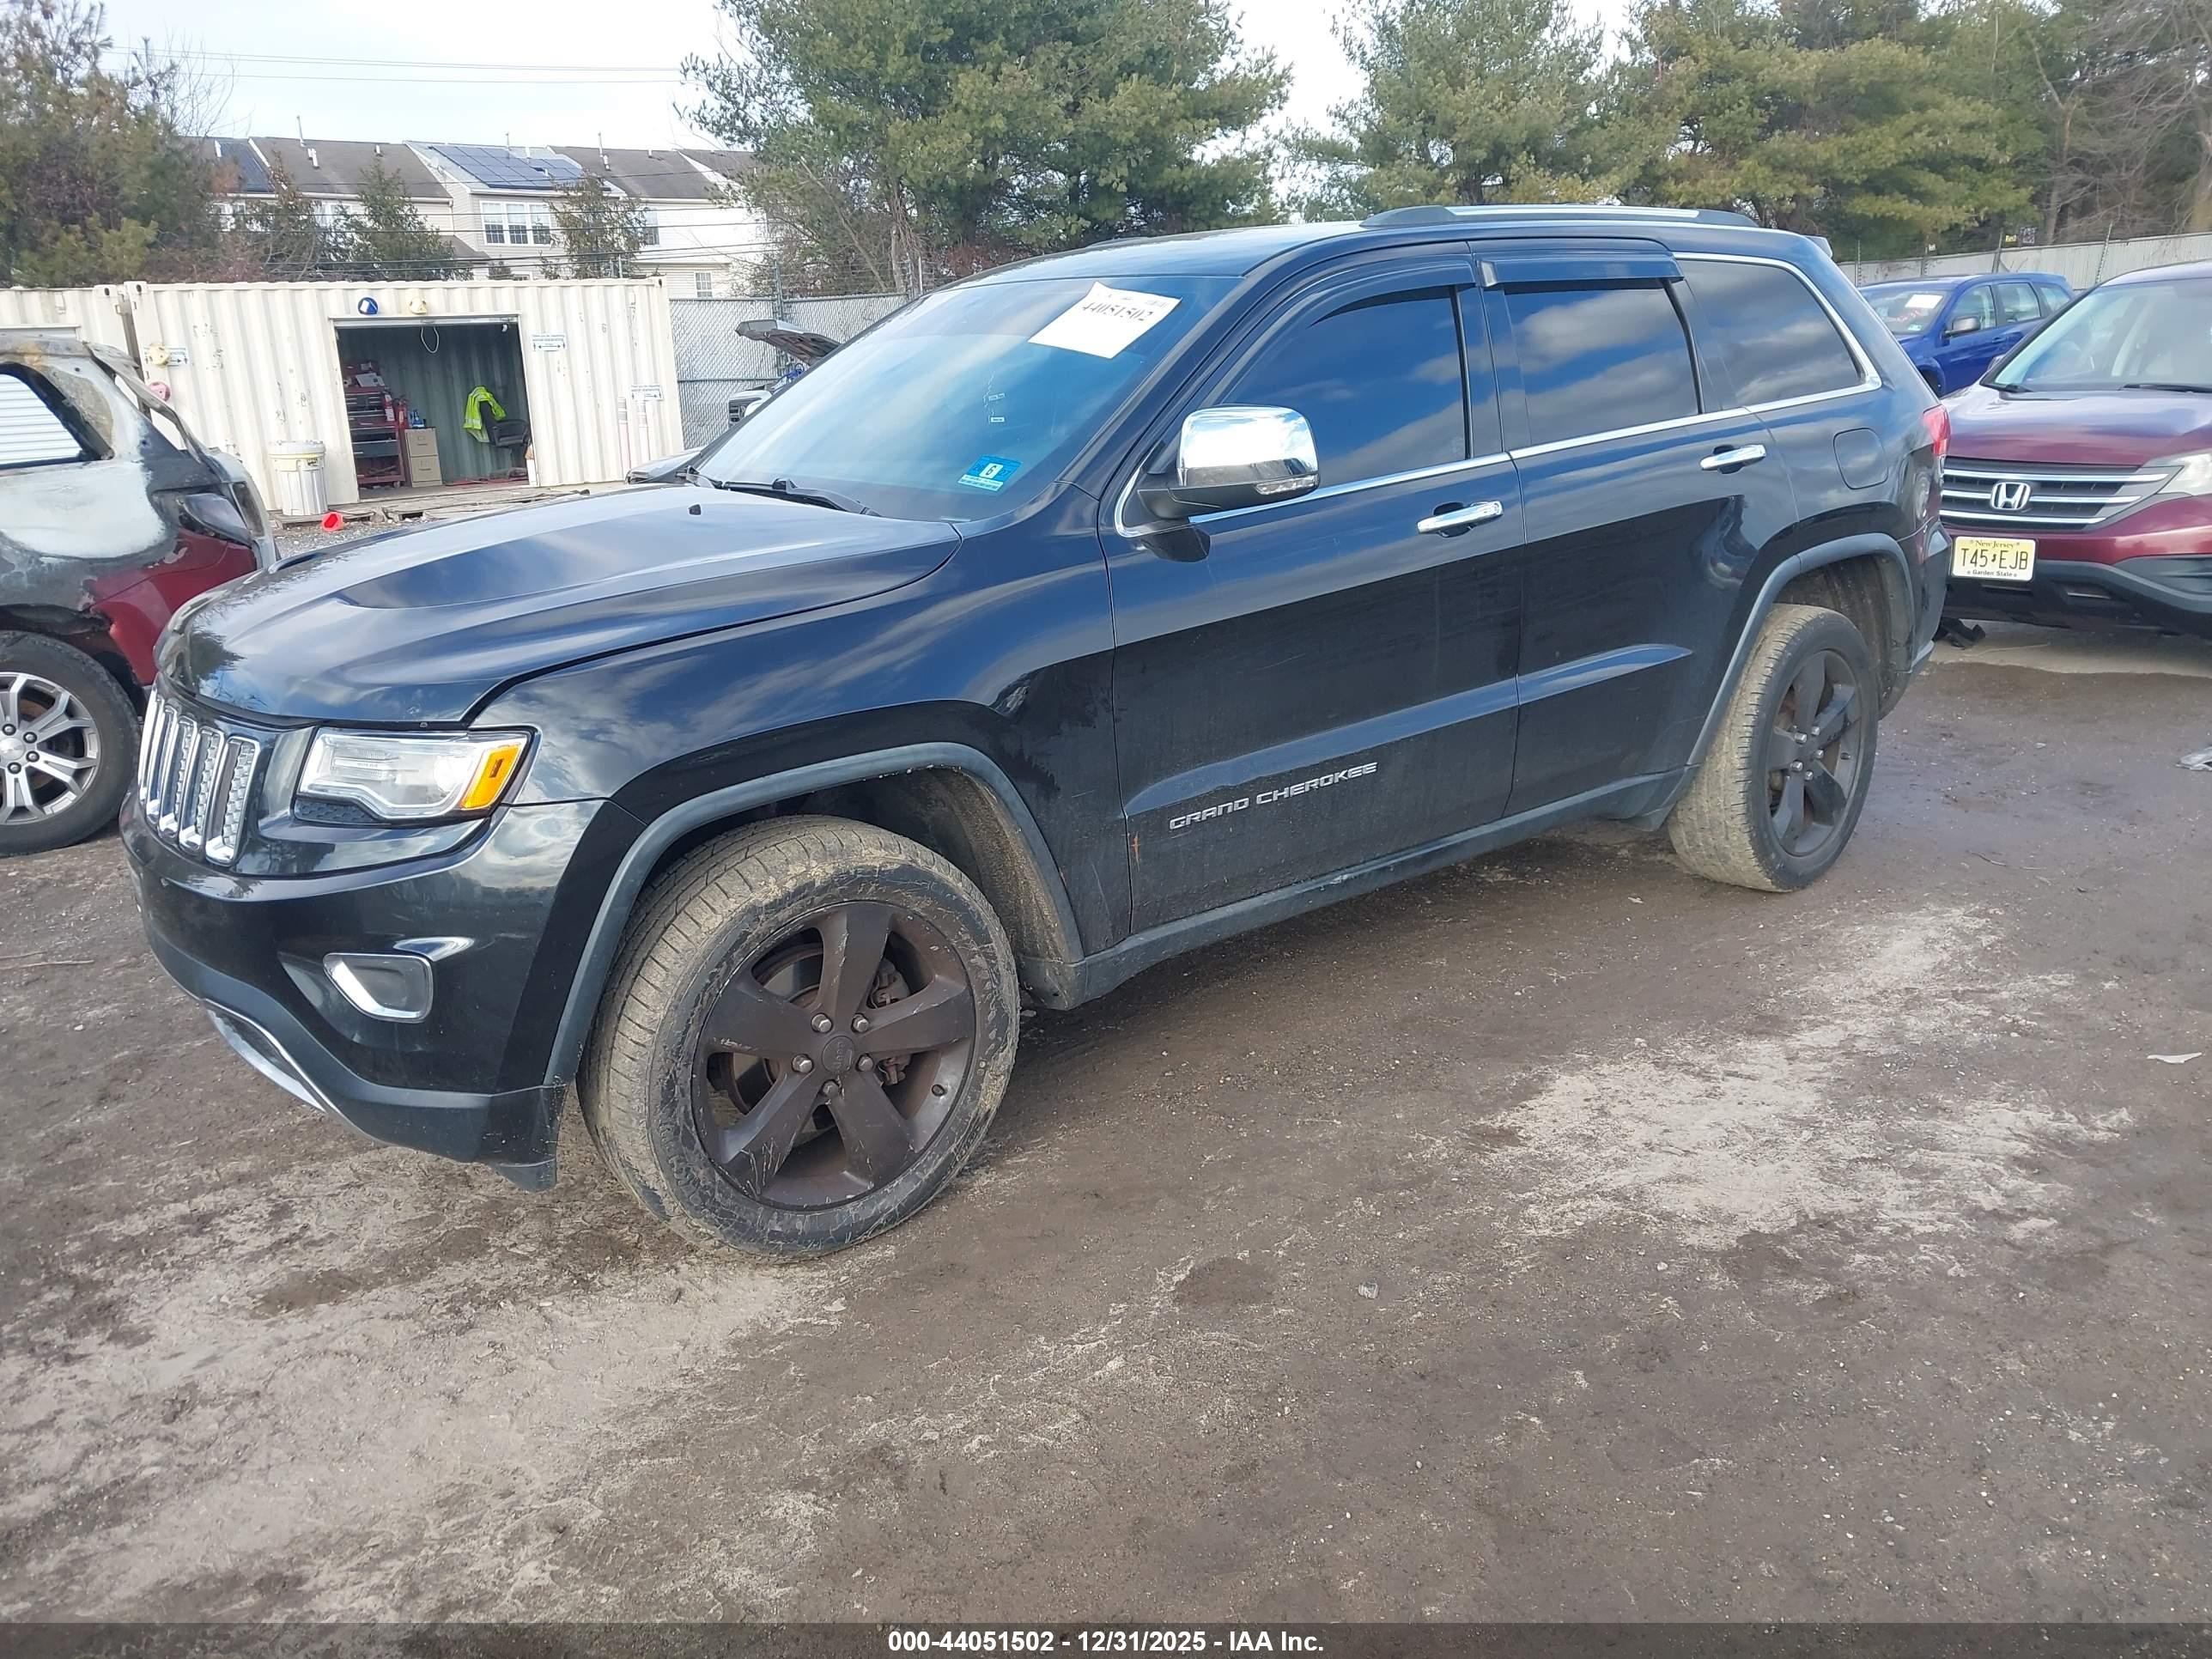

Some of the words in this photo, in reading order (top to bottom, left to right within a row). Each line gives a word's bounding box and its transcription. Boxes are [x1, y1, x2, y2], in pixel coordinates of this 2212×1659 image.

[1975, 539, 1992, 548] New
[1992, 540, 2014, 549] Jersey
[1169, 796, 1250, 830] GRAND
[1255, 762, 1378, 805] CHEROKEE
